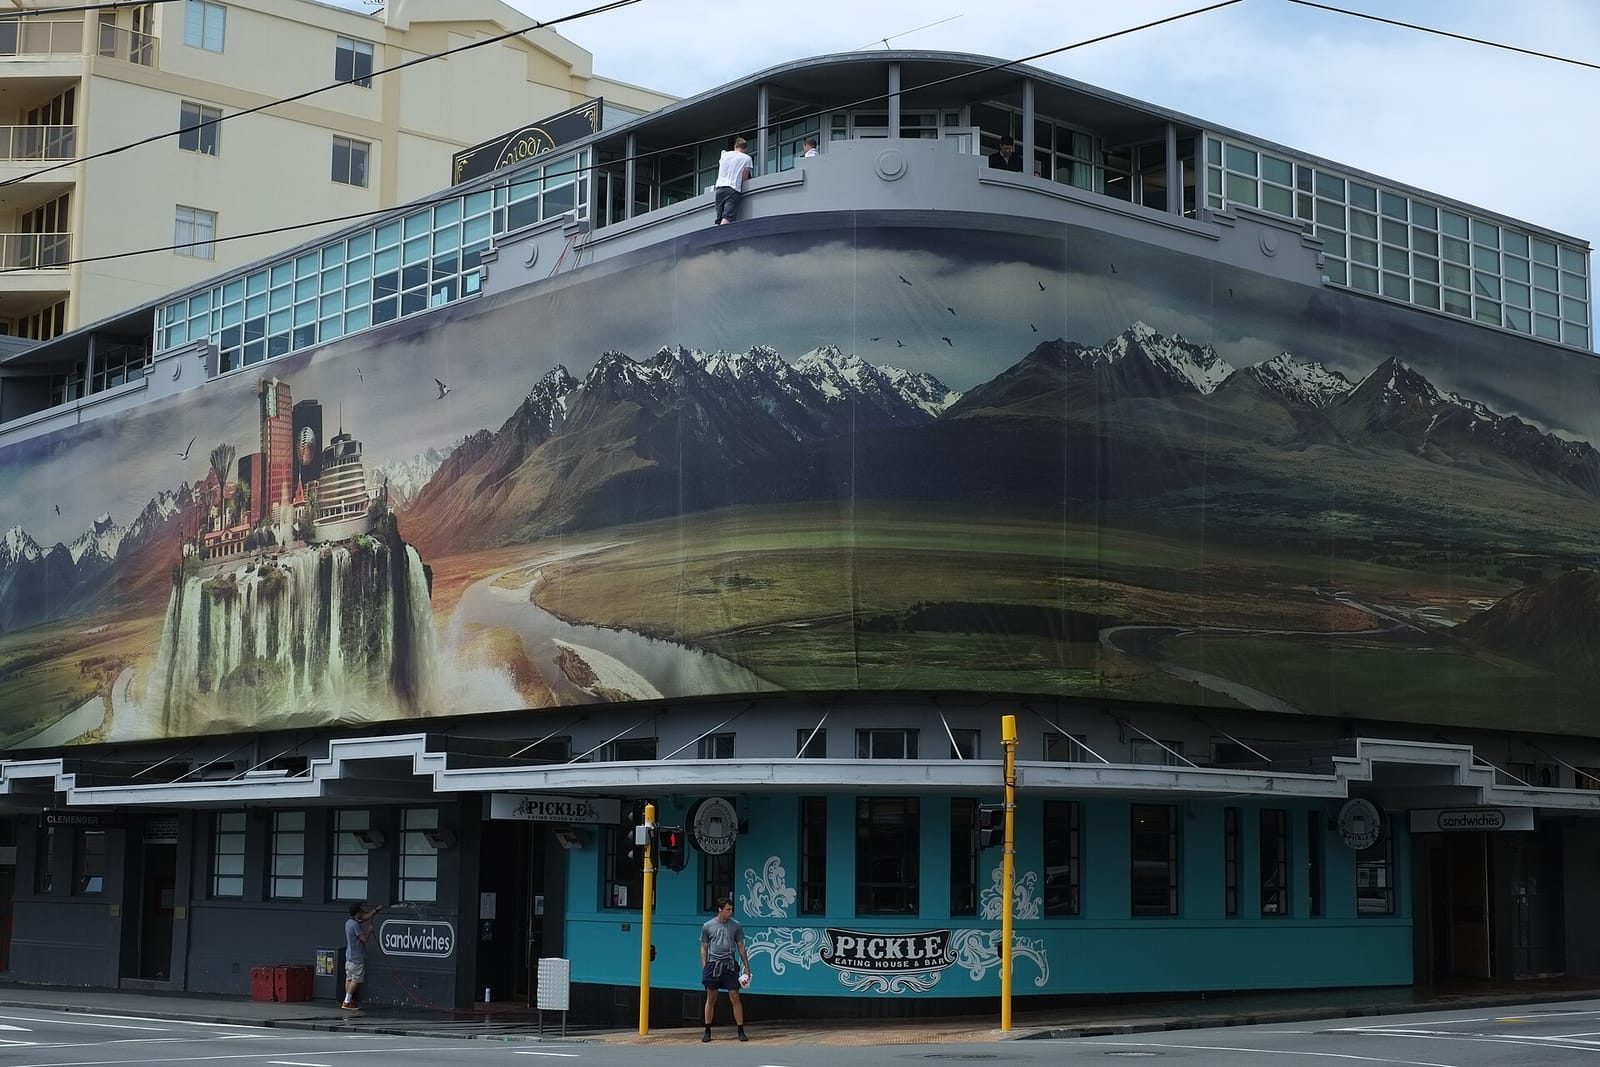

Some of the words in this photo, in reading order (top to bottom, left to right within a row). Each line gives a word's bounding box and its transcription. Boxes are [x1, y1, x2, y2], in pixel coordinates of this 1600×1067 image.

[528, 801, 586, 816] PICKLE
[46, 815, 98, 825] CLEMENGER
[1443, 814, 1500, 827] sandwiches
[704, 837, 727, 845] PICKLE
[385, 927, 450, 951] sandwiches
[834, 936, 942, 959] PICKLE
[834, 957, 870, 967] EATING
[875, 960, 909, 968] HOUSE
[924, 957, 945, 966] BAR
